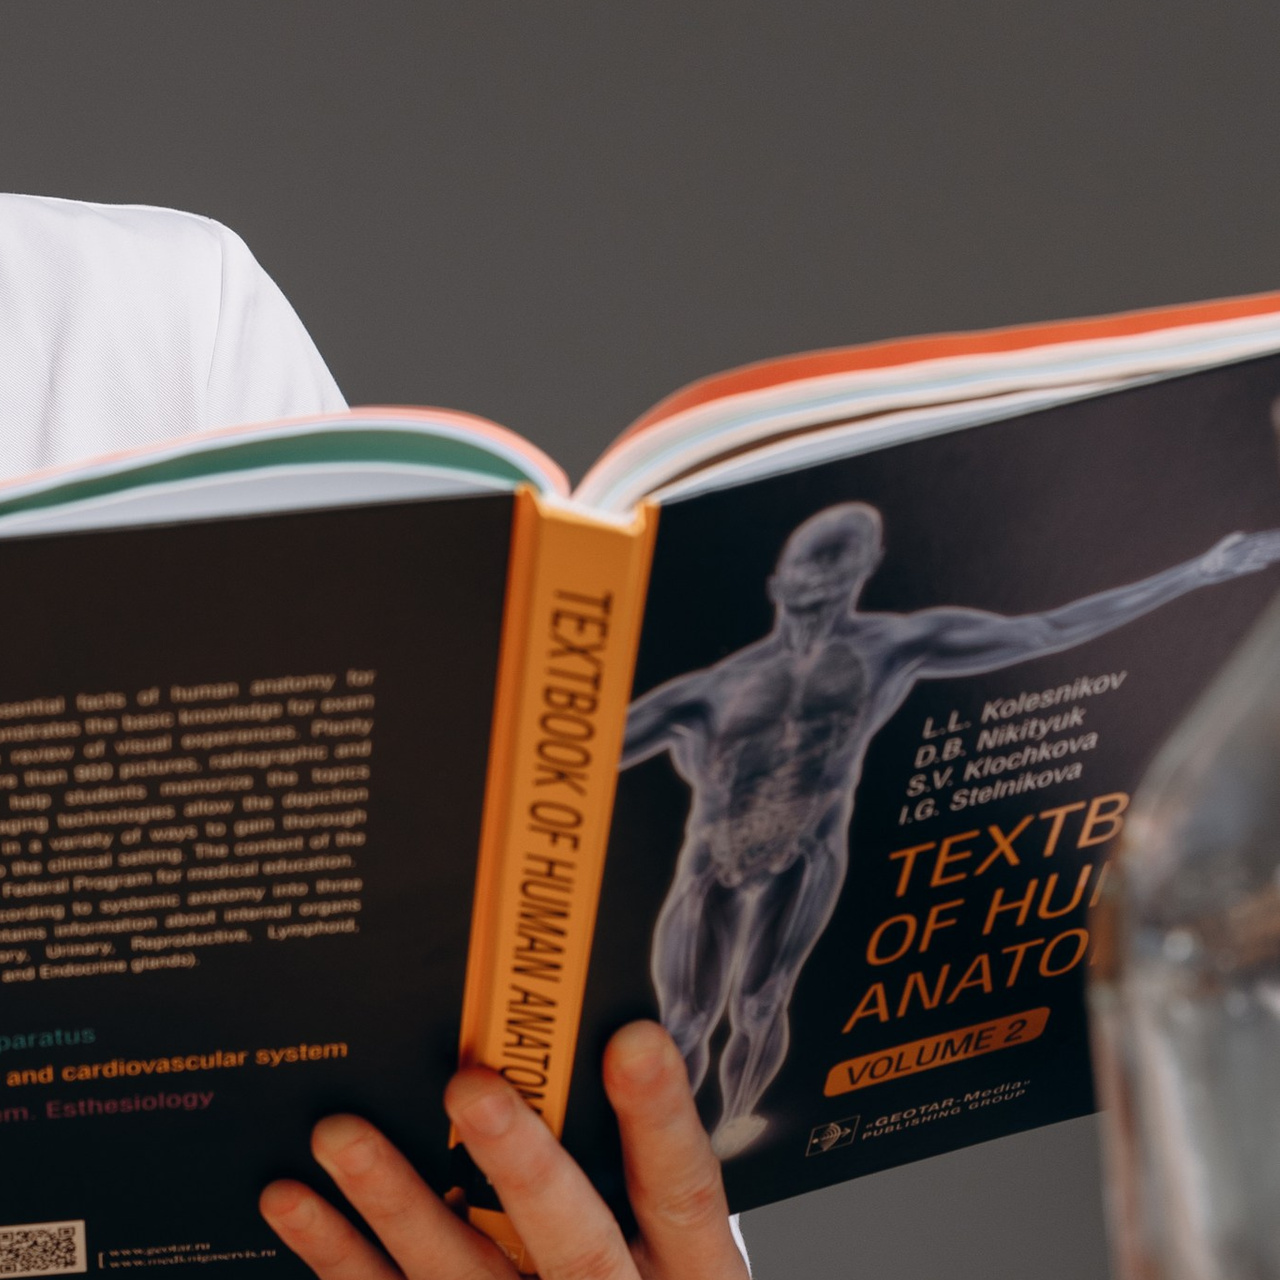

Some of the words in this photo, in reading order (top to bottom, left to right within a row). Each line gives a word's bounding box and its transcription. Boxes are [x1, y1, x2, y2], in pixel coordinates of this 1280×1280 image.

[533, 588, 614, 796] TEXTBOOK
[922, 709, 972, 739] L.L.
[980, 670, 1128, 724] Kolesnikov
[906, 766, 954, 797] S.V.
[963, 731, 1099, 782] Klochkova
[913, 737, 966, 769] D.B.
[976, 705, 1087, 753] Nikityuk
[528, 798, 583, 851] OF
[898, 797, 940, 826] I.G.
[949, 762, 1083, 812] Stelnikova
[888, 791, 1130, 898] TEXTB
[513, 852, 577, 982] HUMAN
[866, 898, 965, 966] OF
[842, 927, 1089, 1035] ANATO
[6, 1064, 55, 1087] and
[61, 1050, 249, 1081] cardiovascular
[255, 1041, 349, 1067] system
[500, 984, 557, 1115] ANATO
[847, 1025, 998, 1086] VOLUME
[1004, 1019, 1027, 1043] 2
[46, 1090, 214, 1119] Esthesiology
[862, 1106, 961, 1140] PUBLISHING
[969, 1089, 1026, 1111] GROUP
